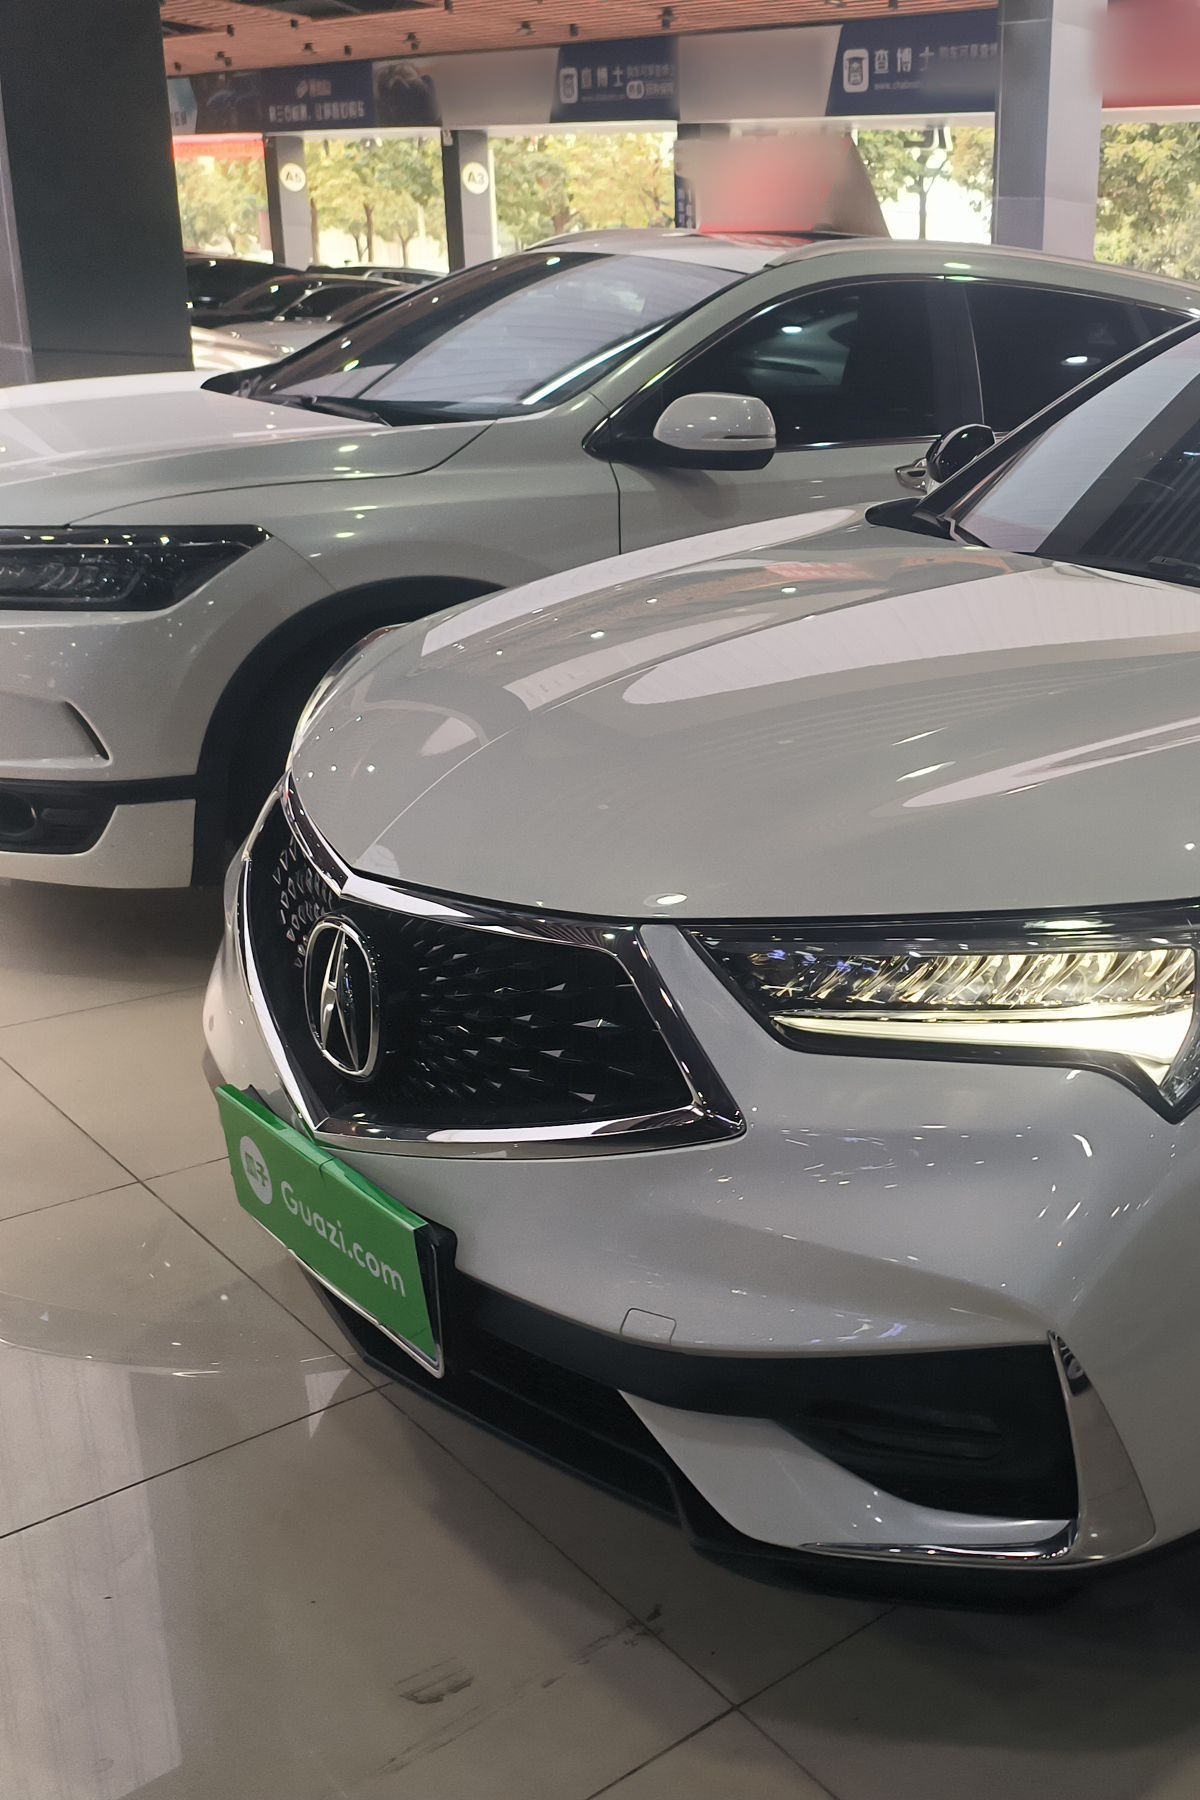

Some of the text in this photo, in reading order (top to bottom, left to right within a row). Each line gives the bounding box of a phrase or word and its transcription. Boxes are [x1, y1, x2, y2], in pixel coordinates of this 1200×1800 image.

[874, 46, 935, 74] 查博士
[280, 1180, 407, 1298] Guazi.com
